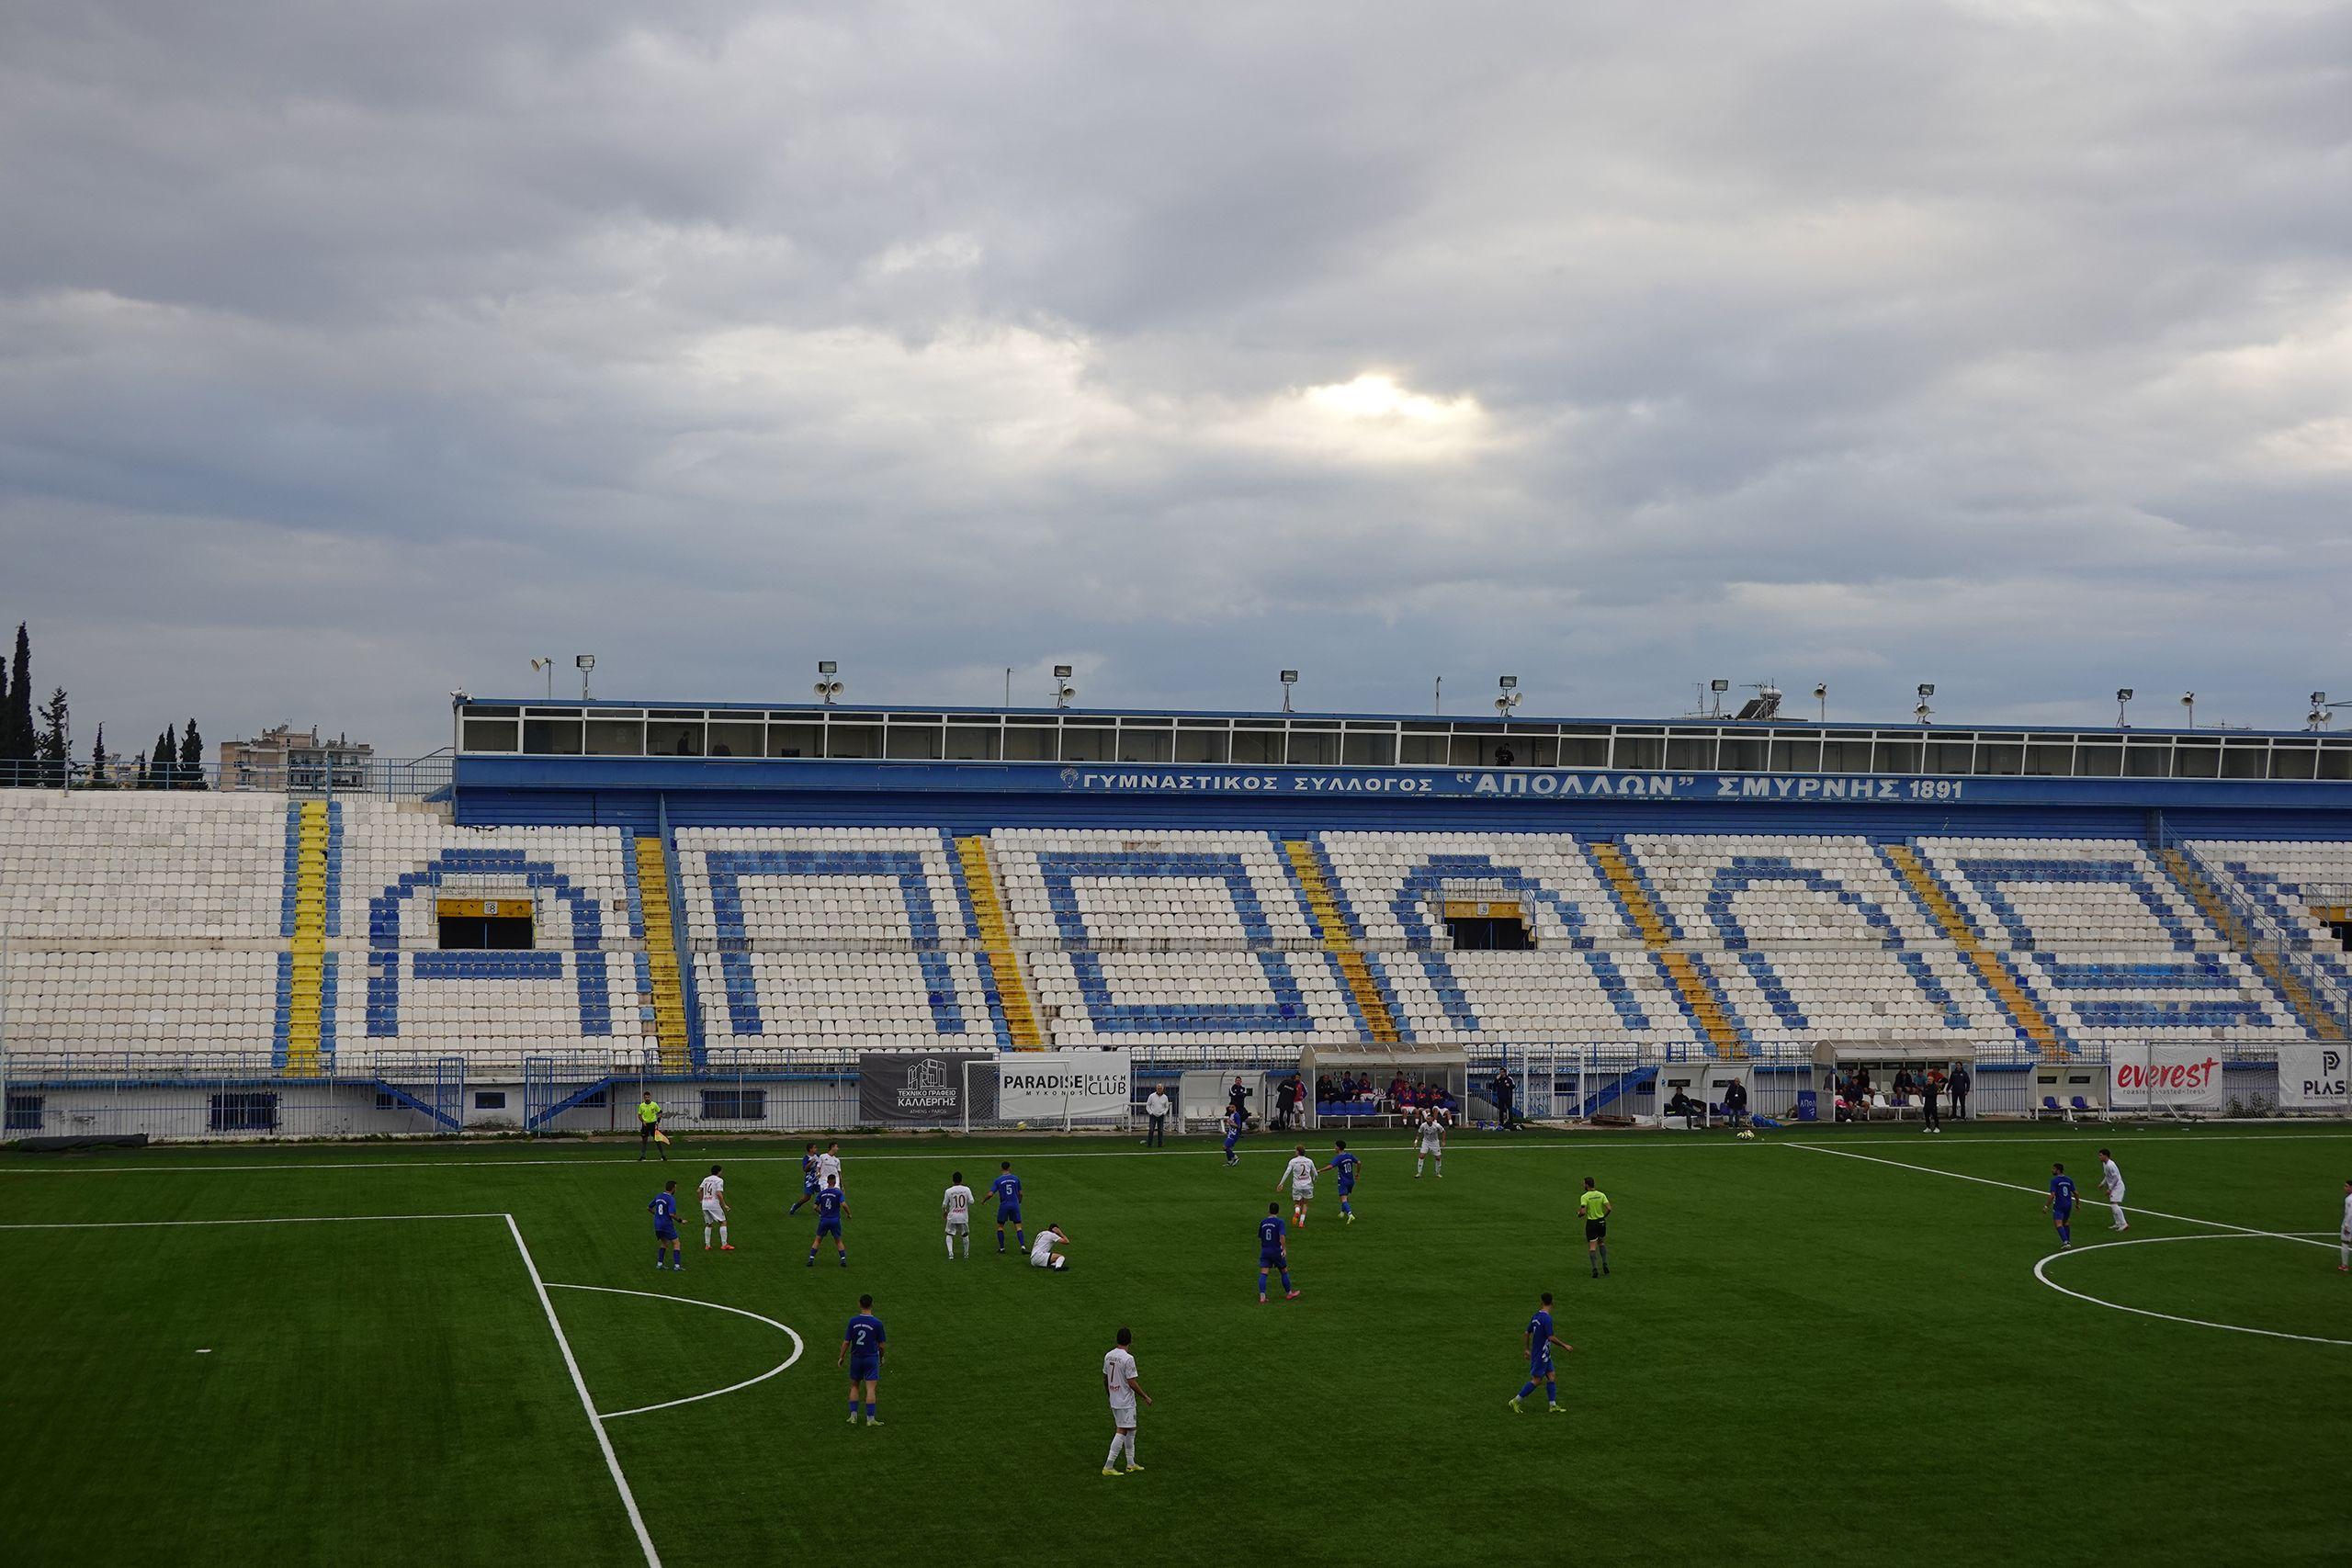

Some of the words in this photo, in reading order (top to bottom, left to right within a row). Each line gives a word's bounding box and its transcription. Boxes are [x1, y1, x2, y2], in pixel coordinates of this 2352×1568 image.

[1083, 773, 1277, 790] ΓΥΜΝΑΣΤΙΚΟΣ
[1294, 777, 1432, 792] ΣΥΛΛΟΓΟΣ
[1717, 777, 1900, 797] ΣΜΥΡΝΗΣ
[1909, 780, 1962, 799] 1891
[2117, 1057, 2220, 1089] everest
[1003, 1075, 1083, 1089] PARADISE
[1088, 1081, 1126, 1095] CLUB
[898, 1098, 956, 1107] ΚΑΛΛΕΡΓΗΣ
[1299, 1164, 1306, 1177] 2
[704, 1182, 713, 1196] 14
[1006, 1184, 1012, 1195] 5
[825, 1198, 831, 1210] 4
[953, 1194, 966, 1208] 10
[658, 1204, 663, 1215] 8
[1265, 1228, 1272, 1241] 6
[856, 1329, 866, 1345] 2
[1109, 1361, 1115, 1382] 7
